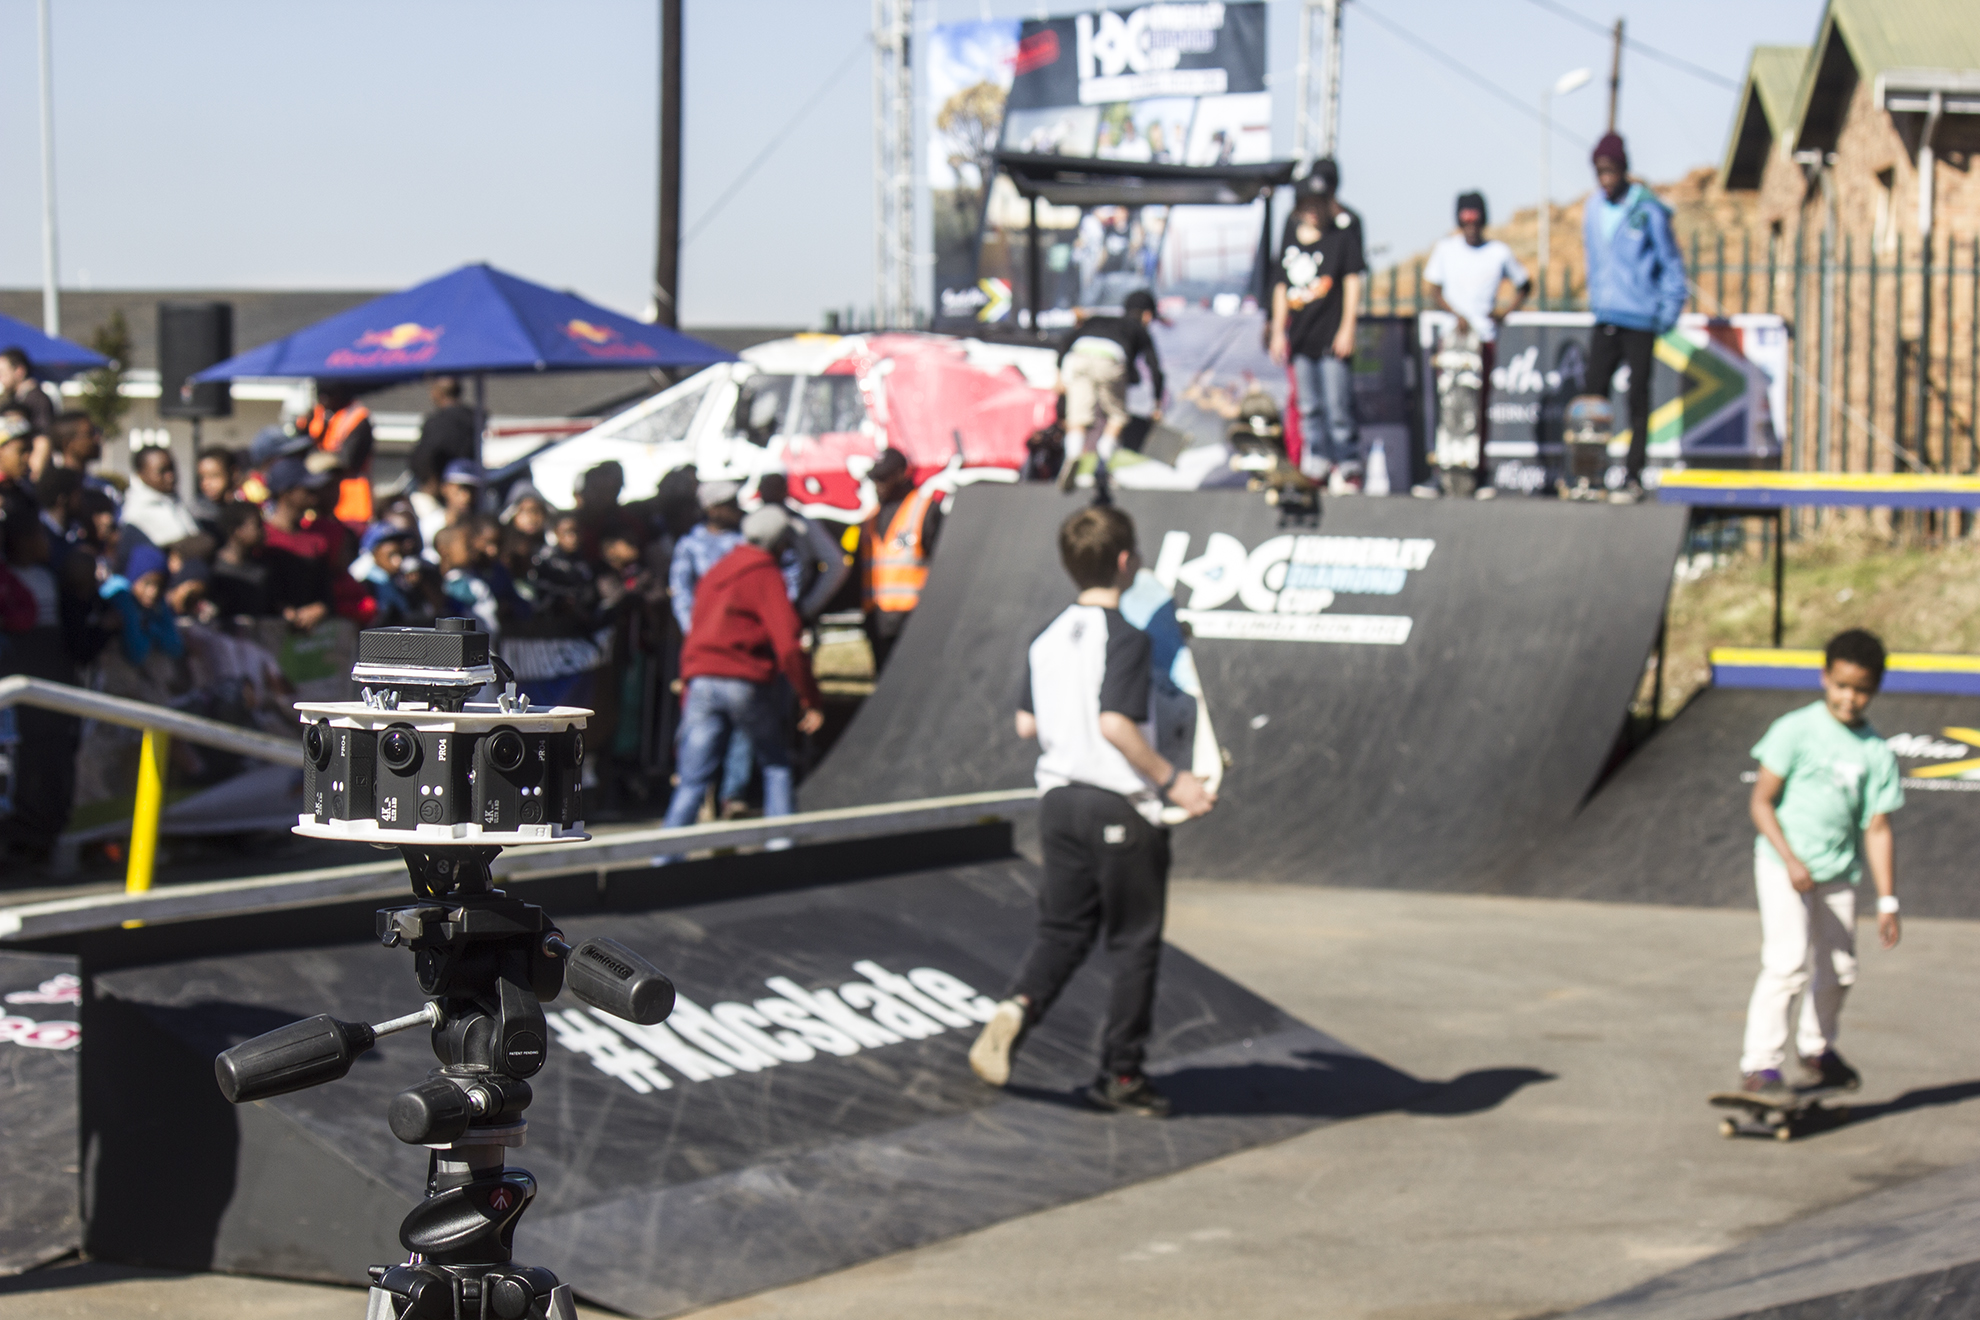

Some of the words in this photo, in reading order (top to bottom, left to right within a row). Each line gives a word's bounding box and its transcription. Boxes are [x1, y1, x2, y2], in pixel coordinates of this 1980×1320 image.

[438, 739, 447, 762] PRO4
[538, 740, 546, 762] PRO4
[381, 807, 391, 822] 4K
[484, 810, 494, 824] 4K
[585, 946, 629, 977] Manfrotto
